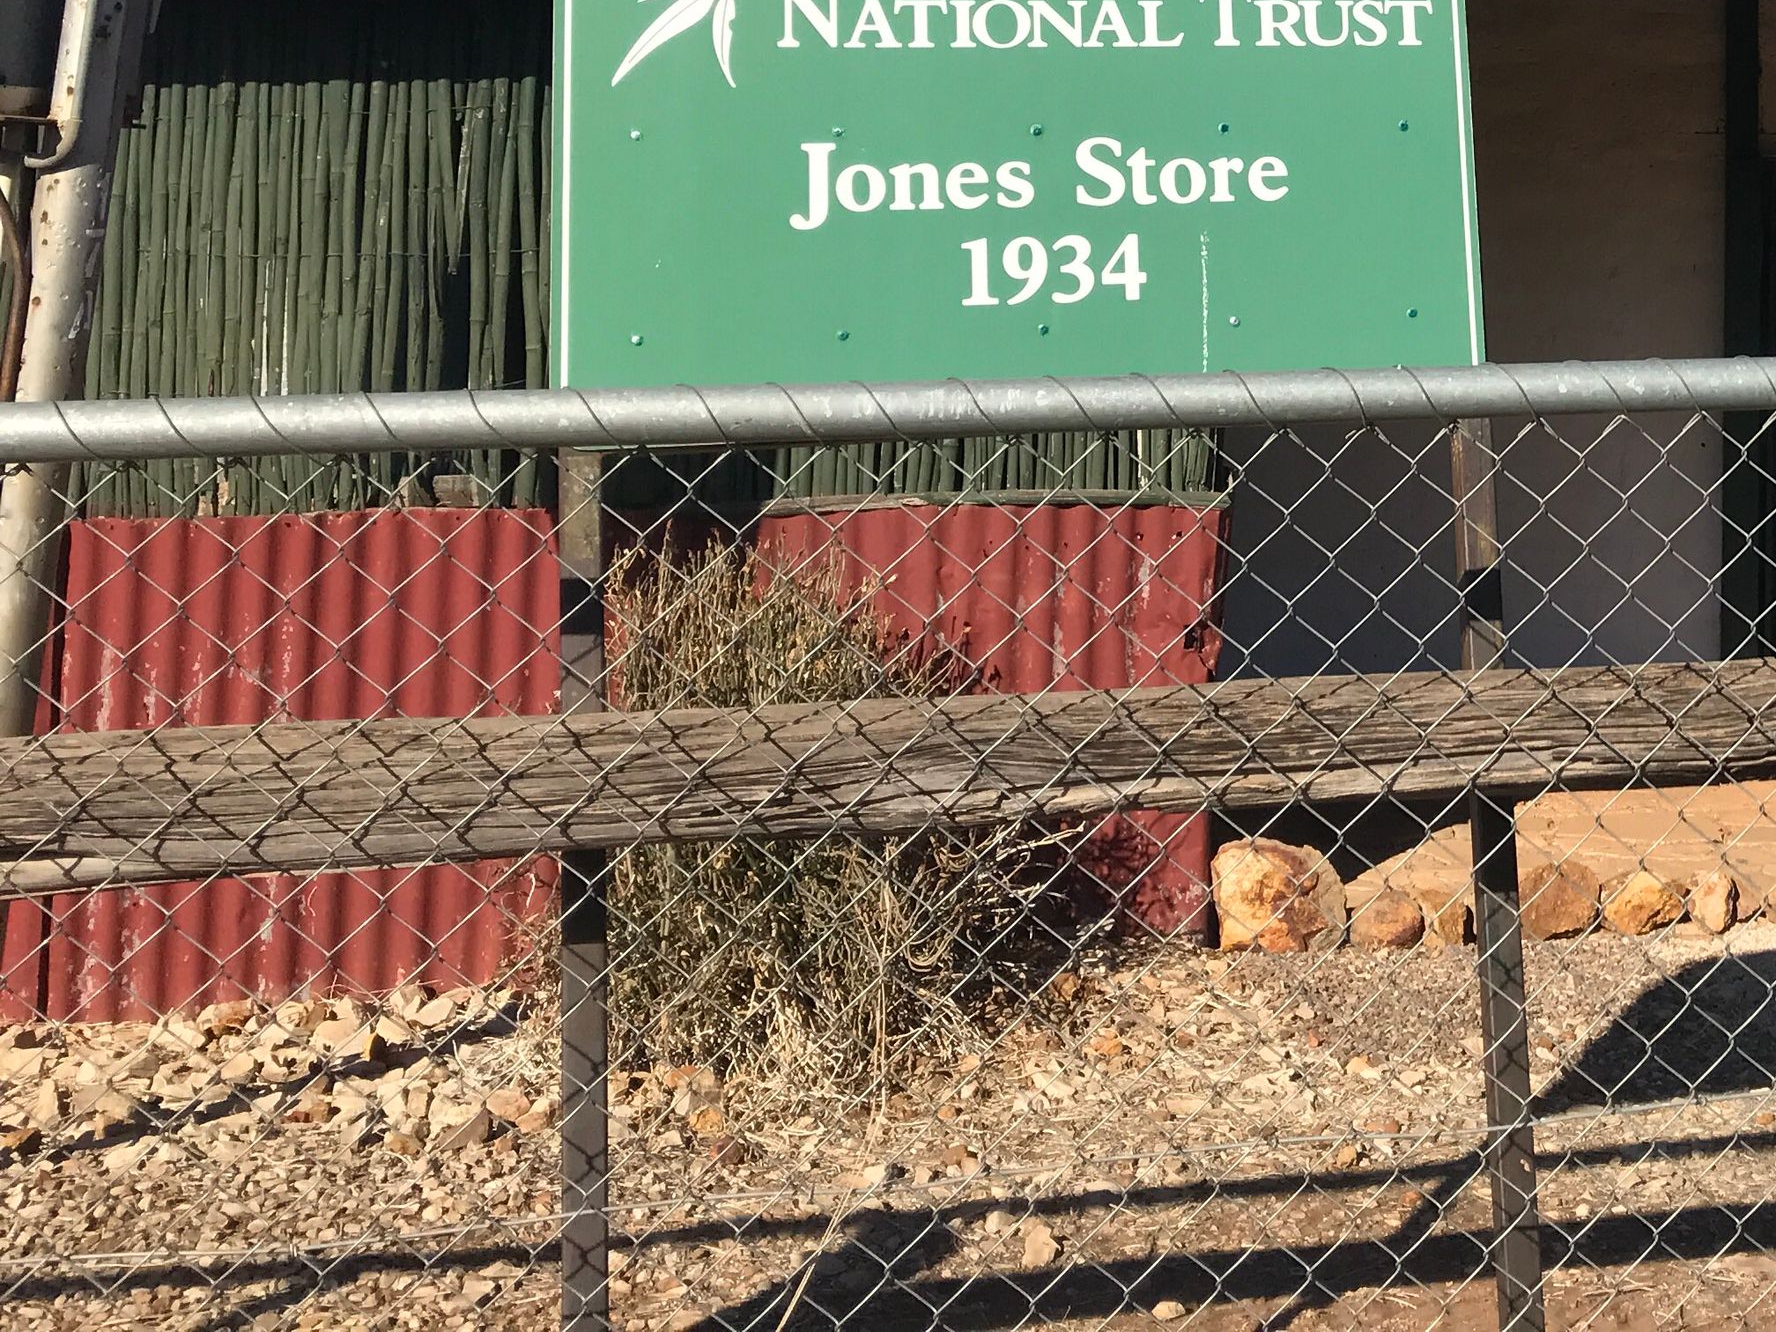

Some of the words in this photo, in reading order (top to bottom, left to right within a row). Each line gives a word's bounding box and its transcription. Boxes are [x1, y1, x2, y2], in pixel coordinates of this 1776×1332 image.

[788, 141, 1035, 231] Jones
[1075, 136, 1290, 207] Store
[961, 233, 1148, 306] 1934
